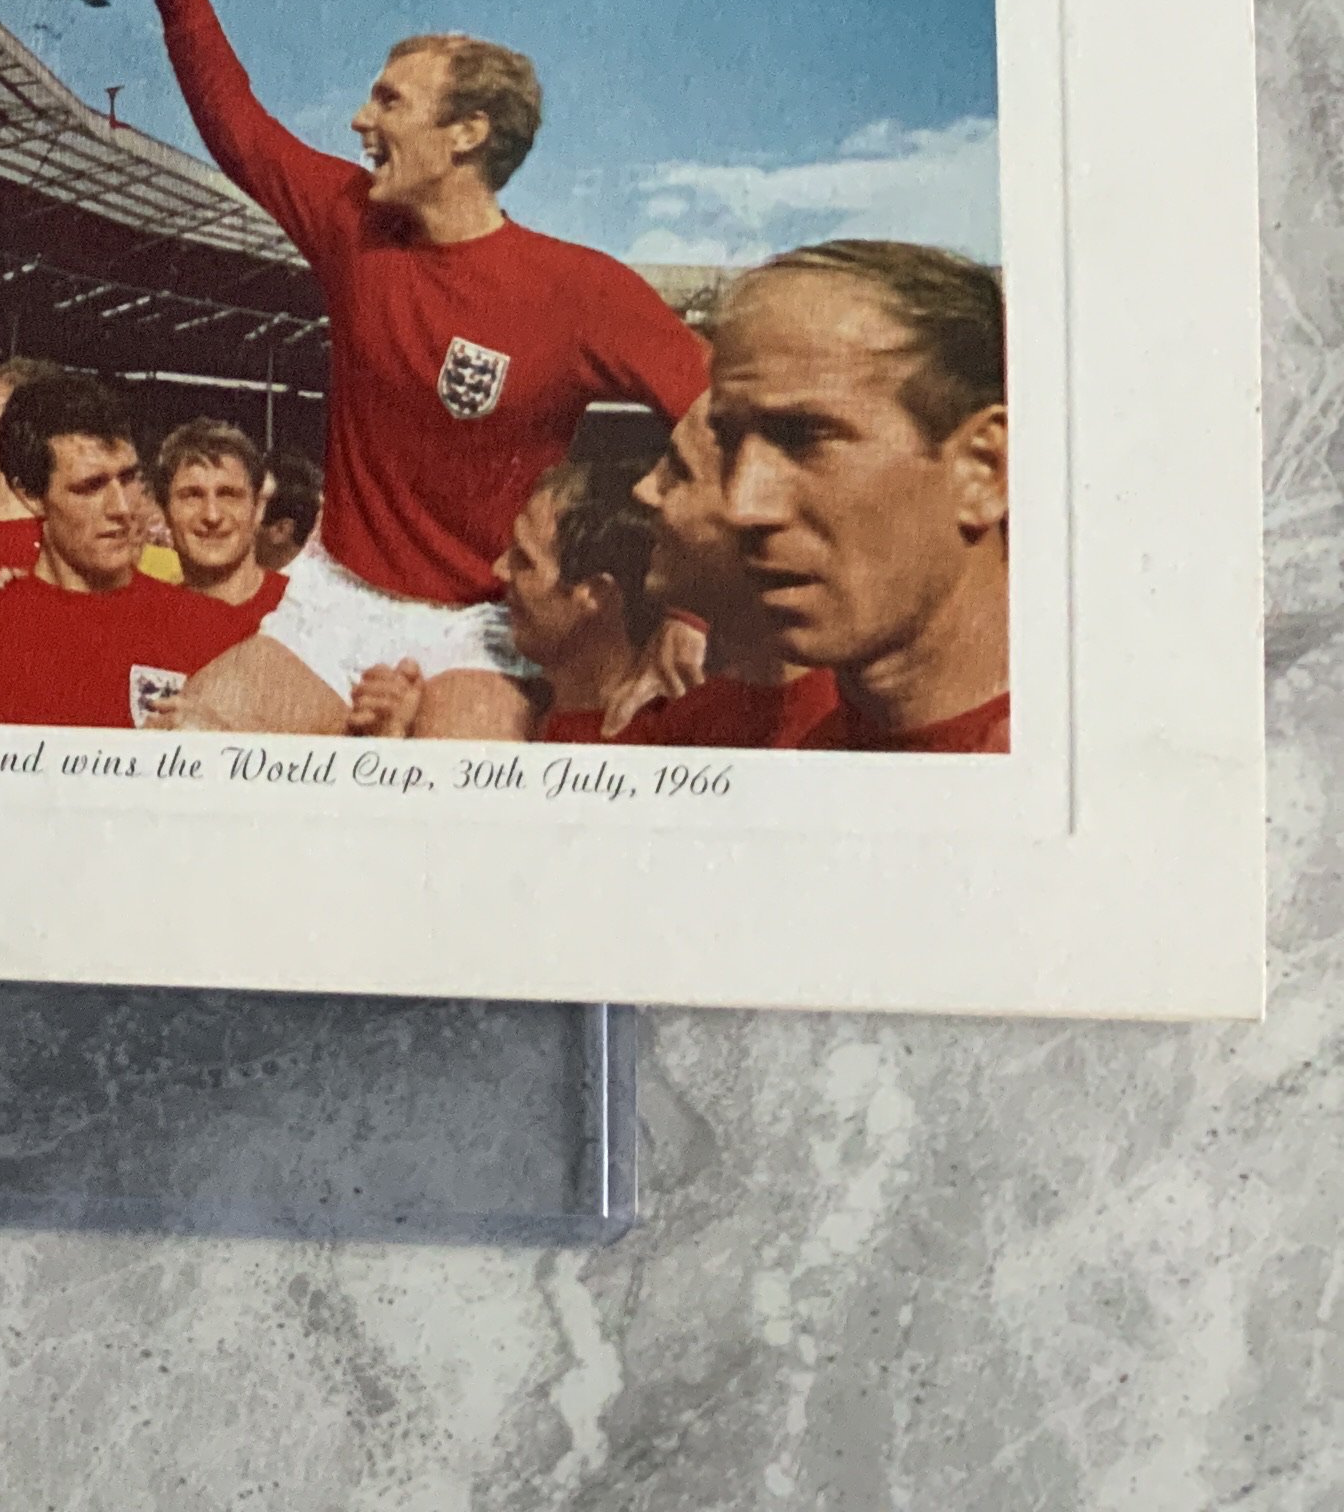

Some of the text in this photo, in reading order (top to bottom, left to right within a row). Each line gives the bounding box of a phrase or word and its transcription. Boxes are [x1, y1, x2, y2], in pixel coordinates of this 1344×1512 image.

[61, 748, 138, 778] wins
[156, 745, 204, 780] the
[220, 746, 336, 785] World
[351, 752, 437, 794] Cup,
[453, 758, 526, 791] 30th
[542, 760, 638, 801] July,
[653, 764, 734, 798] 1966
